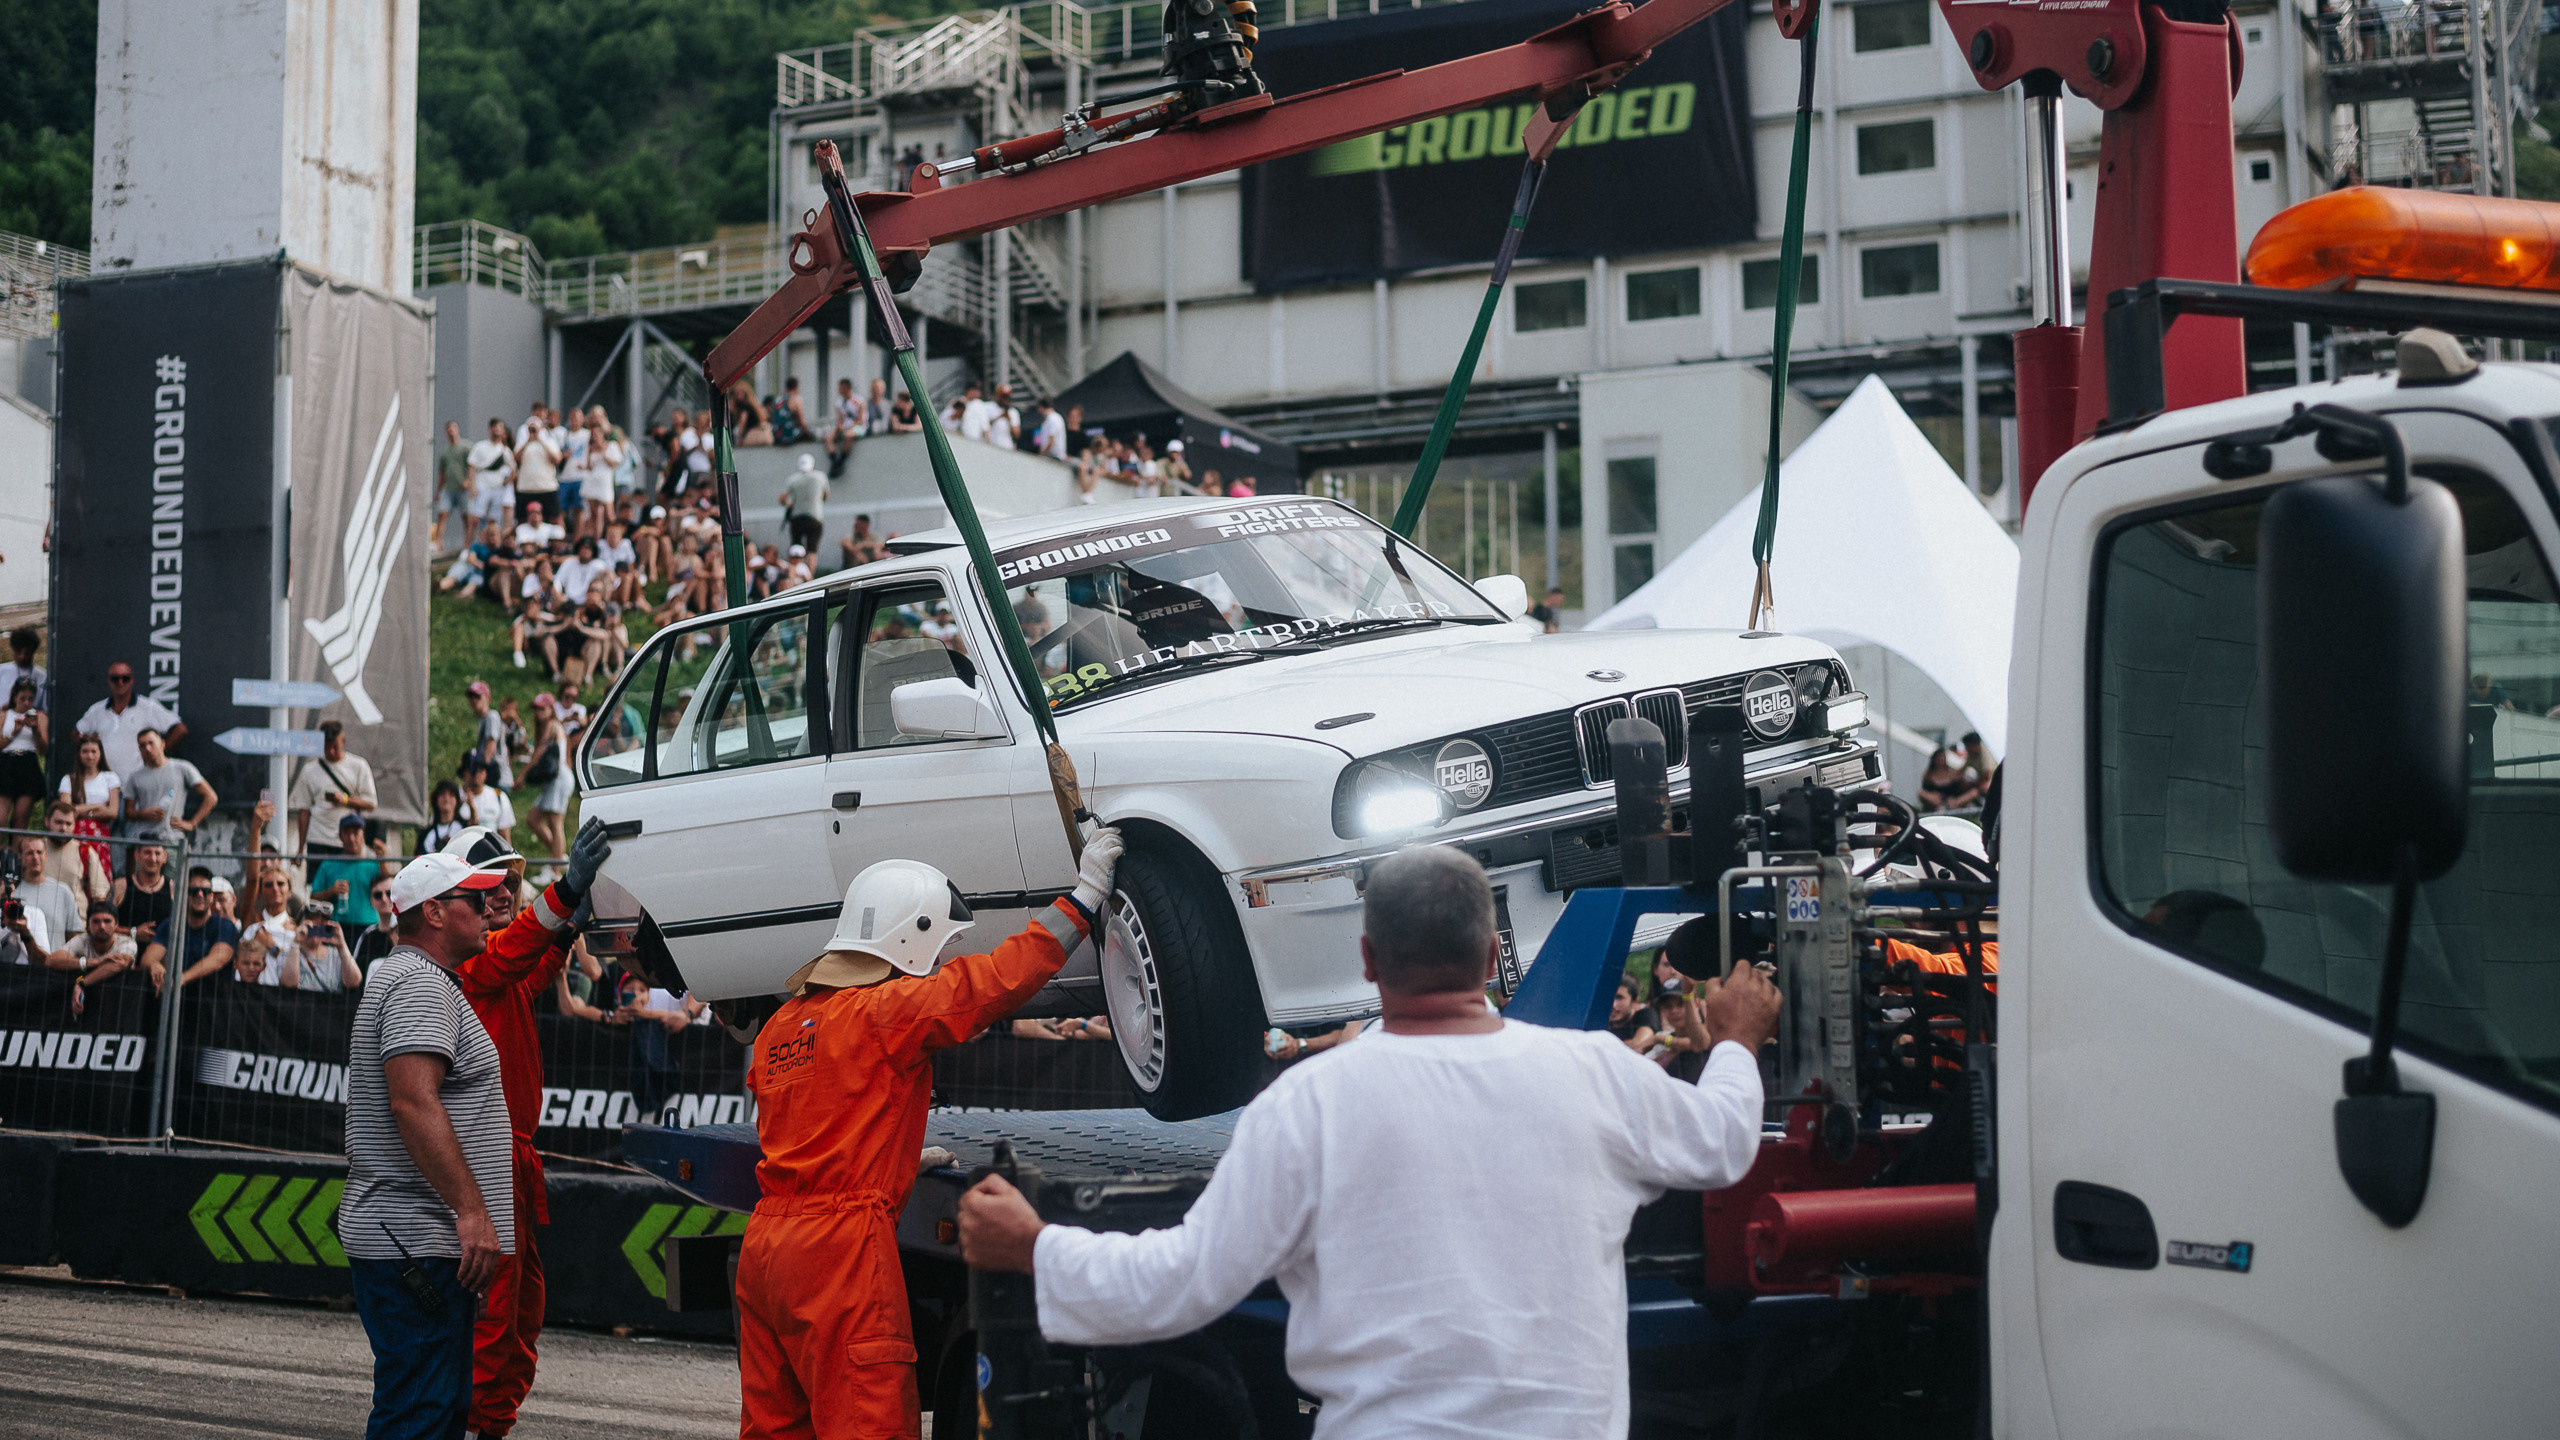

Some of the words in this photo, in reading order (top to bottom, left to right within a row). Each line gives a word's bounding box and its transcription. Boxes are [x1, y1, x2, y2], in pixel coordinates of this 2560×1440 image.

[2060, 1, 2080, 10] GROUP
[2080, 0, 2111, 9] COMPANY
[1377, 82, 1697, 168] GROUDED
[1218, 514, 1362, 539] FIGHTERS
[1227, 503, 1325, 526] DRIFT
[149, 354, 187, 716] #GROUNDEDEVEN
[998, 528, 1172, 581] GROUNDED
[1750, 692, 1792, 716] Hella
[1441, 762, 1487, 787] Hella
[768, 1033, 815, 1065] SOCHI
[766, 1054, 814, 1076] AUTODROM
[539, 1087, 748, 1129] GROND
